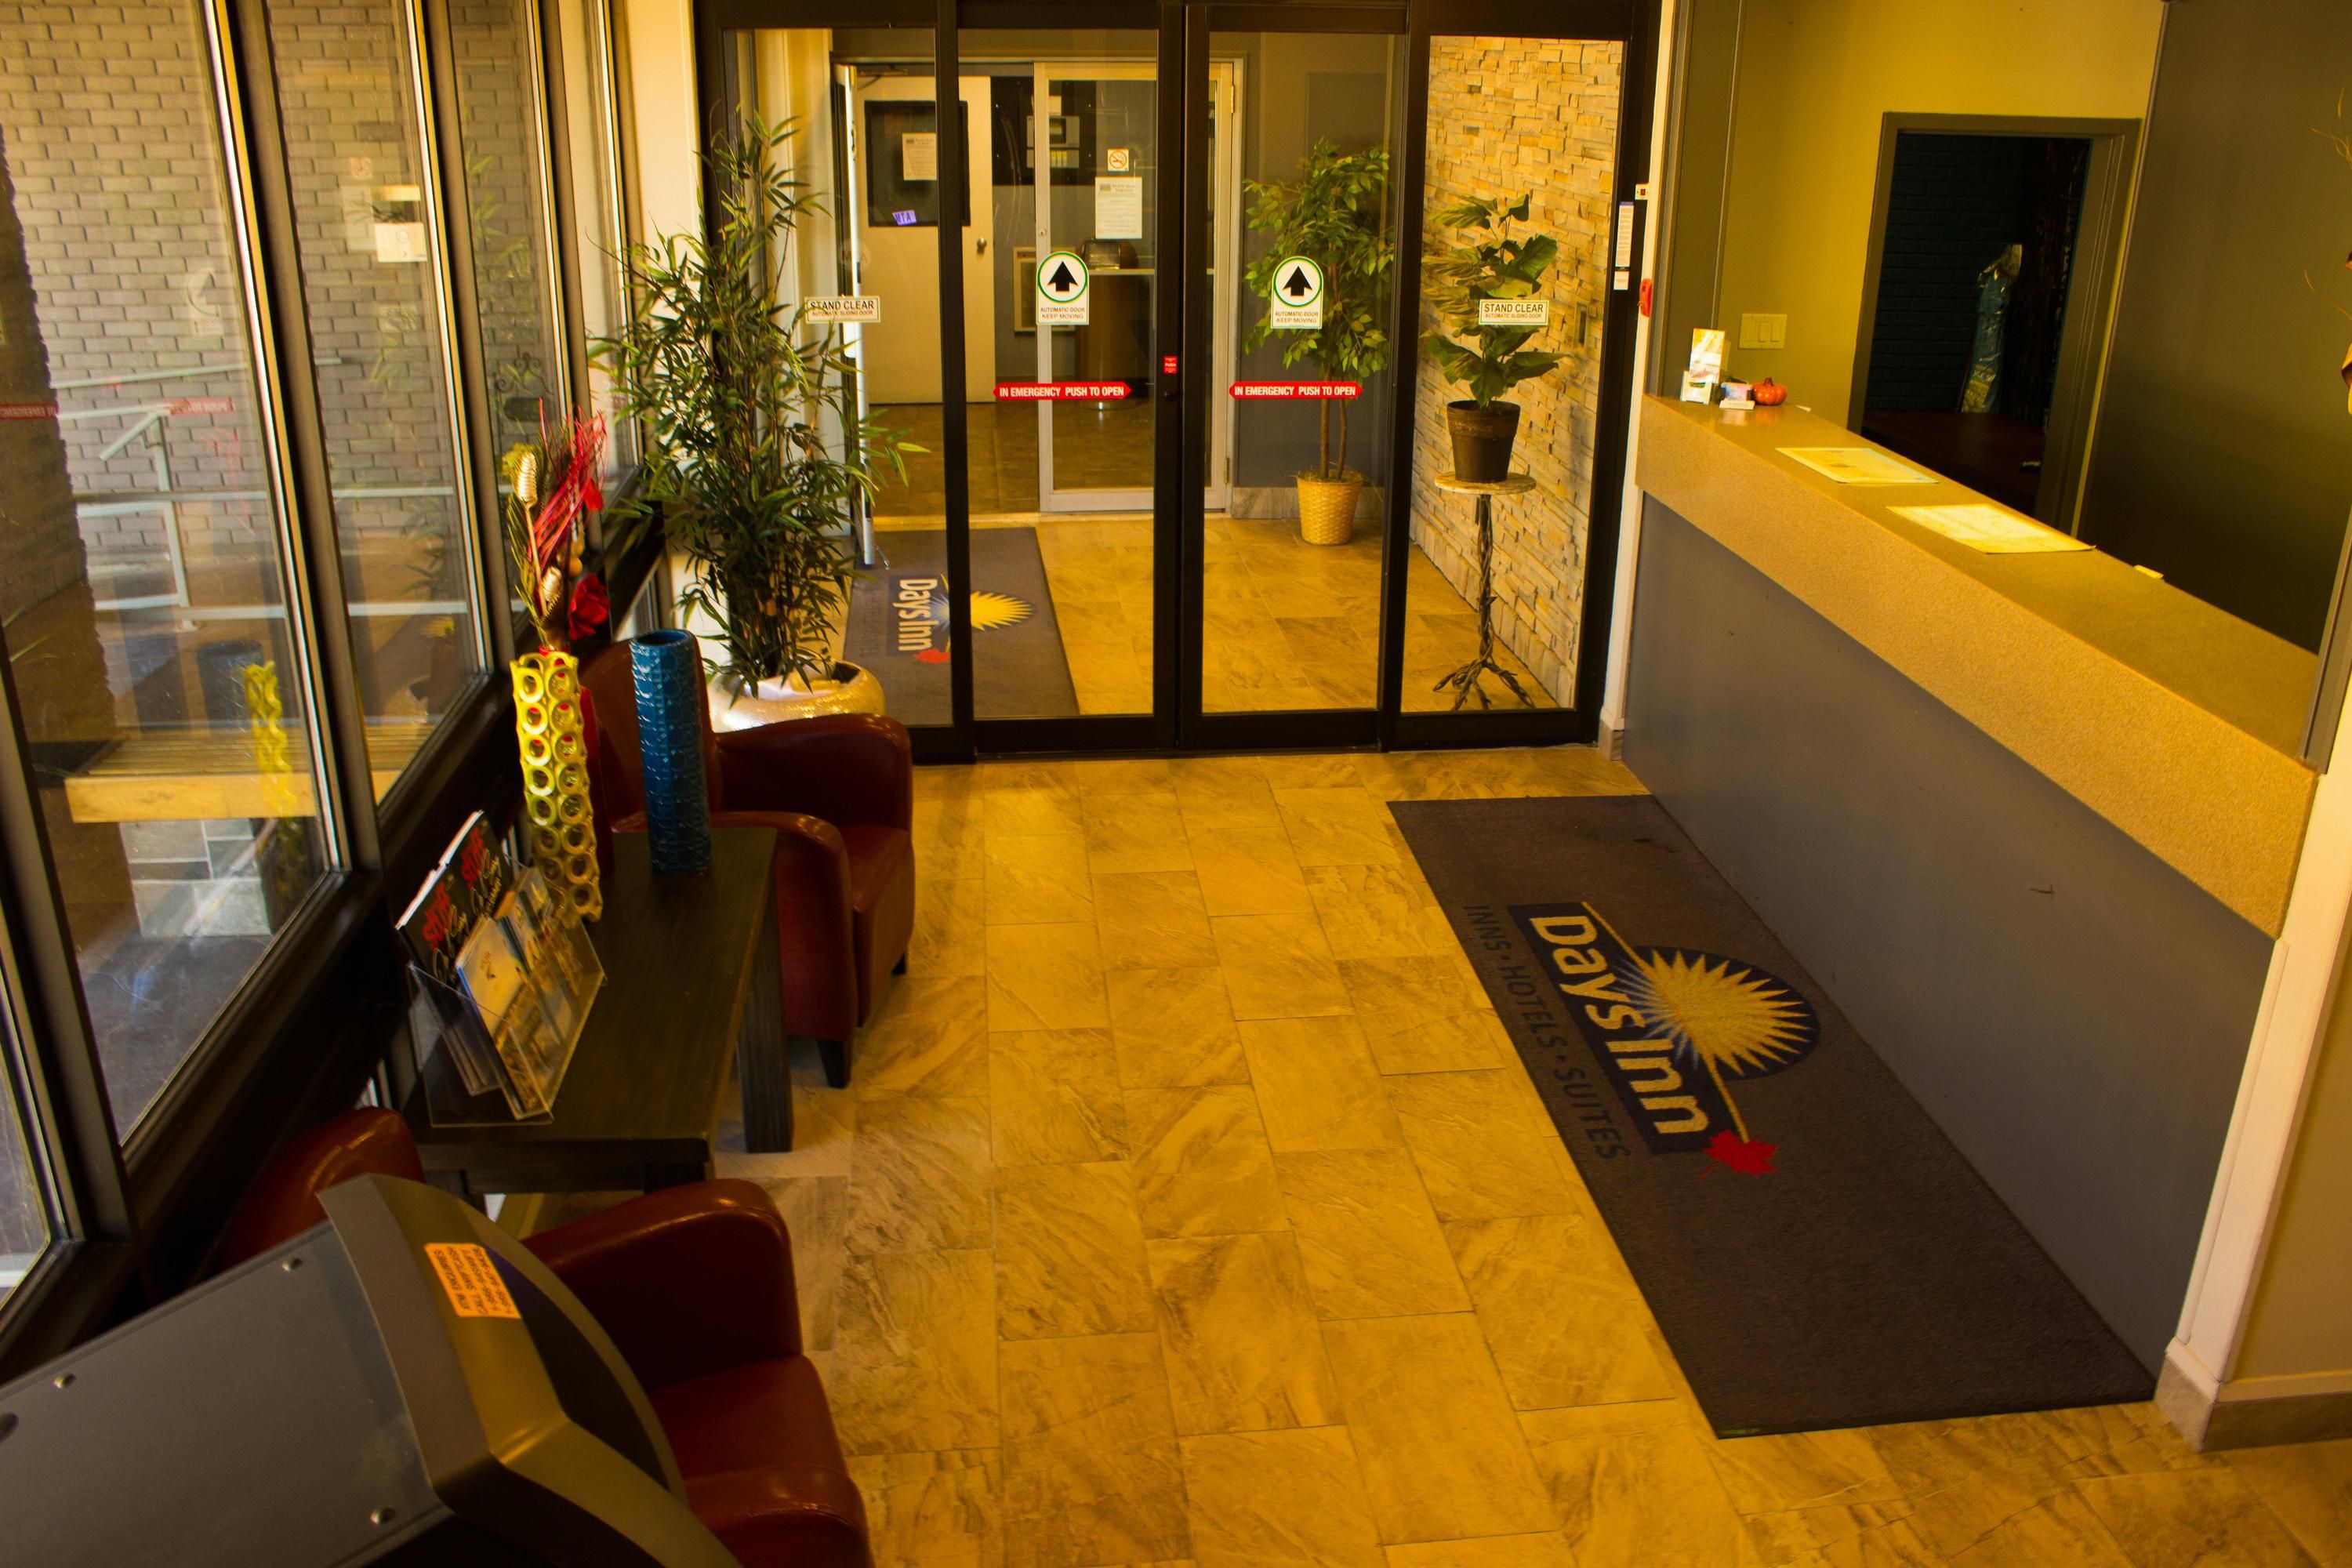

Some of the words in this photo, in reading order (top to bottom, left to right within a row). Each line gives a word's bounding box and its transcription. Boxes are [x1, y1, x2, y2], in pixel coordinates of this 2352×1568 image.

[810, 300, 840, 310] STAND
[843, 300, 874, 310] CLEAR
[1484, 303, 1513, 313] STAND
[1515, 303, 1544, 313] CLEAR
[999, 387, 1009, 397] IN
[1011, 387, 1061, 397] EMERGENCY
[1065, 387, 1087, 397] PUSH
[1089, 387, 1100, 396] TO
[1102, 387, 1124, 396] OPEN
[1234, 386, 1243, 395] IN
[1245, 386, 1294, 396] EMERGENCY
[1298, 386, 1320, 395] PUSH
[1322, 386, 1333, 395] TO
[1334, 386, 1356, 395] OPEN
[892, 579, 938, 619] Days
[898, 619, 939, 652] Inn
[1463, 905, 1512, 952] INNS
[1499, 964, 1566, 1051] HOTELS
[1552, 1067, 1632, 1160] SUITES
[1529, 915, 1646, 1030] Days
[1606, 1038, 1710, 1135] Inn
